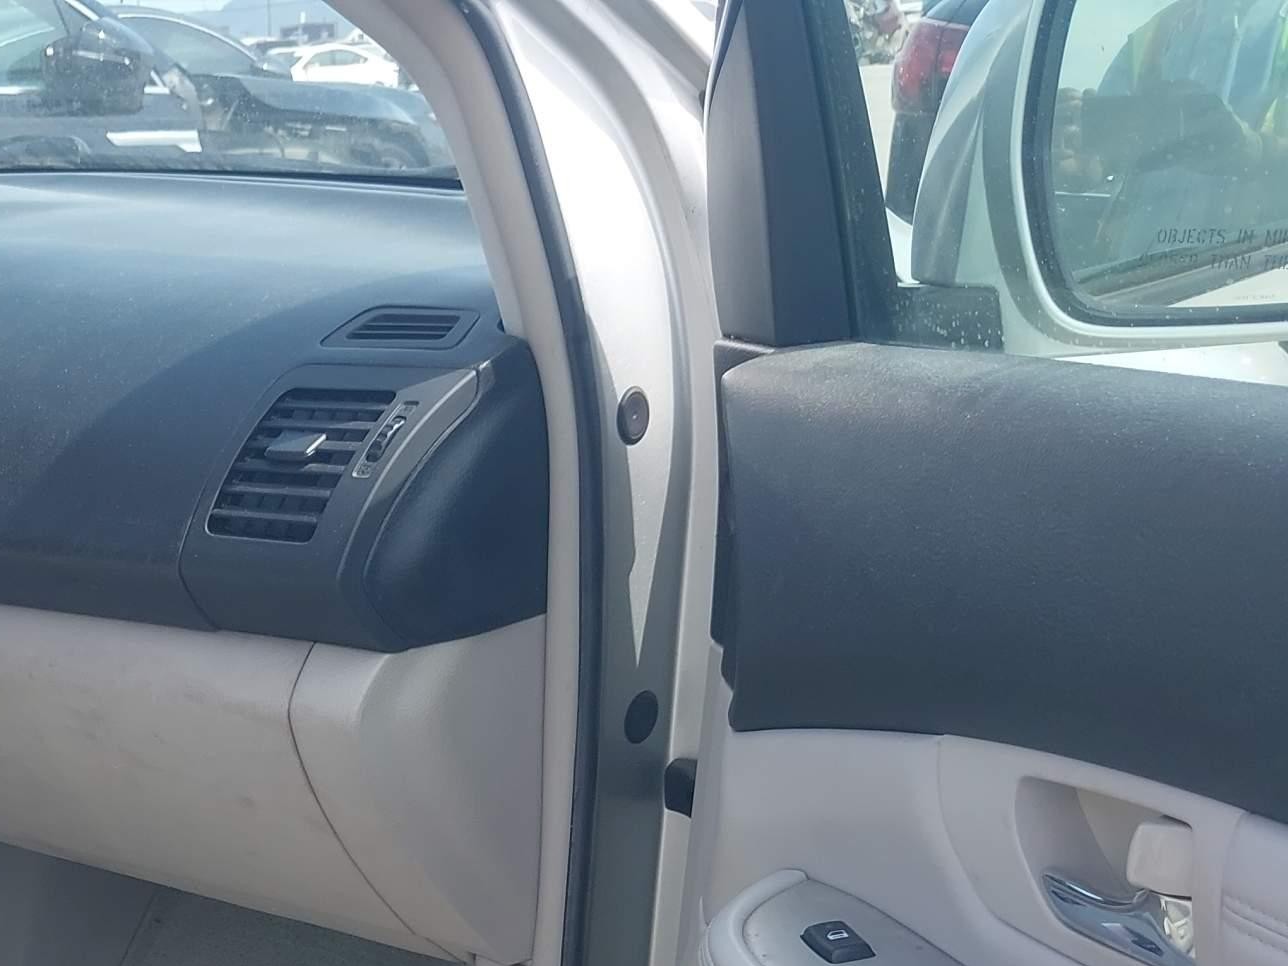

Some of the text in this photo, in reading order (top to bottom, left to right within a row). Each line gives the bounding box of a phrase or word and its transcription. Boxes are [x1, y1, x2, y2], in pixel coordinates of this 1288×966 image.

[1157, 228, 1227, 244] OBJECTS
[1238, 228, 1255, 244] IN
[1212, 254, 1252, 270] THAN
